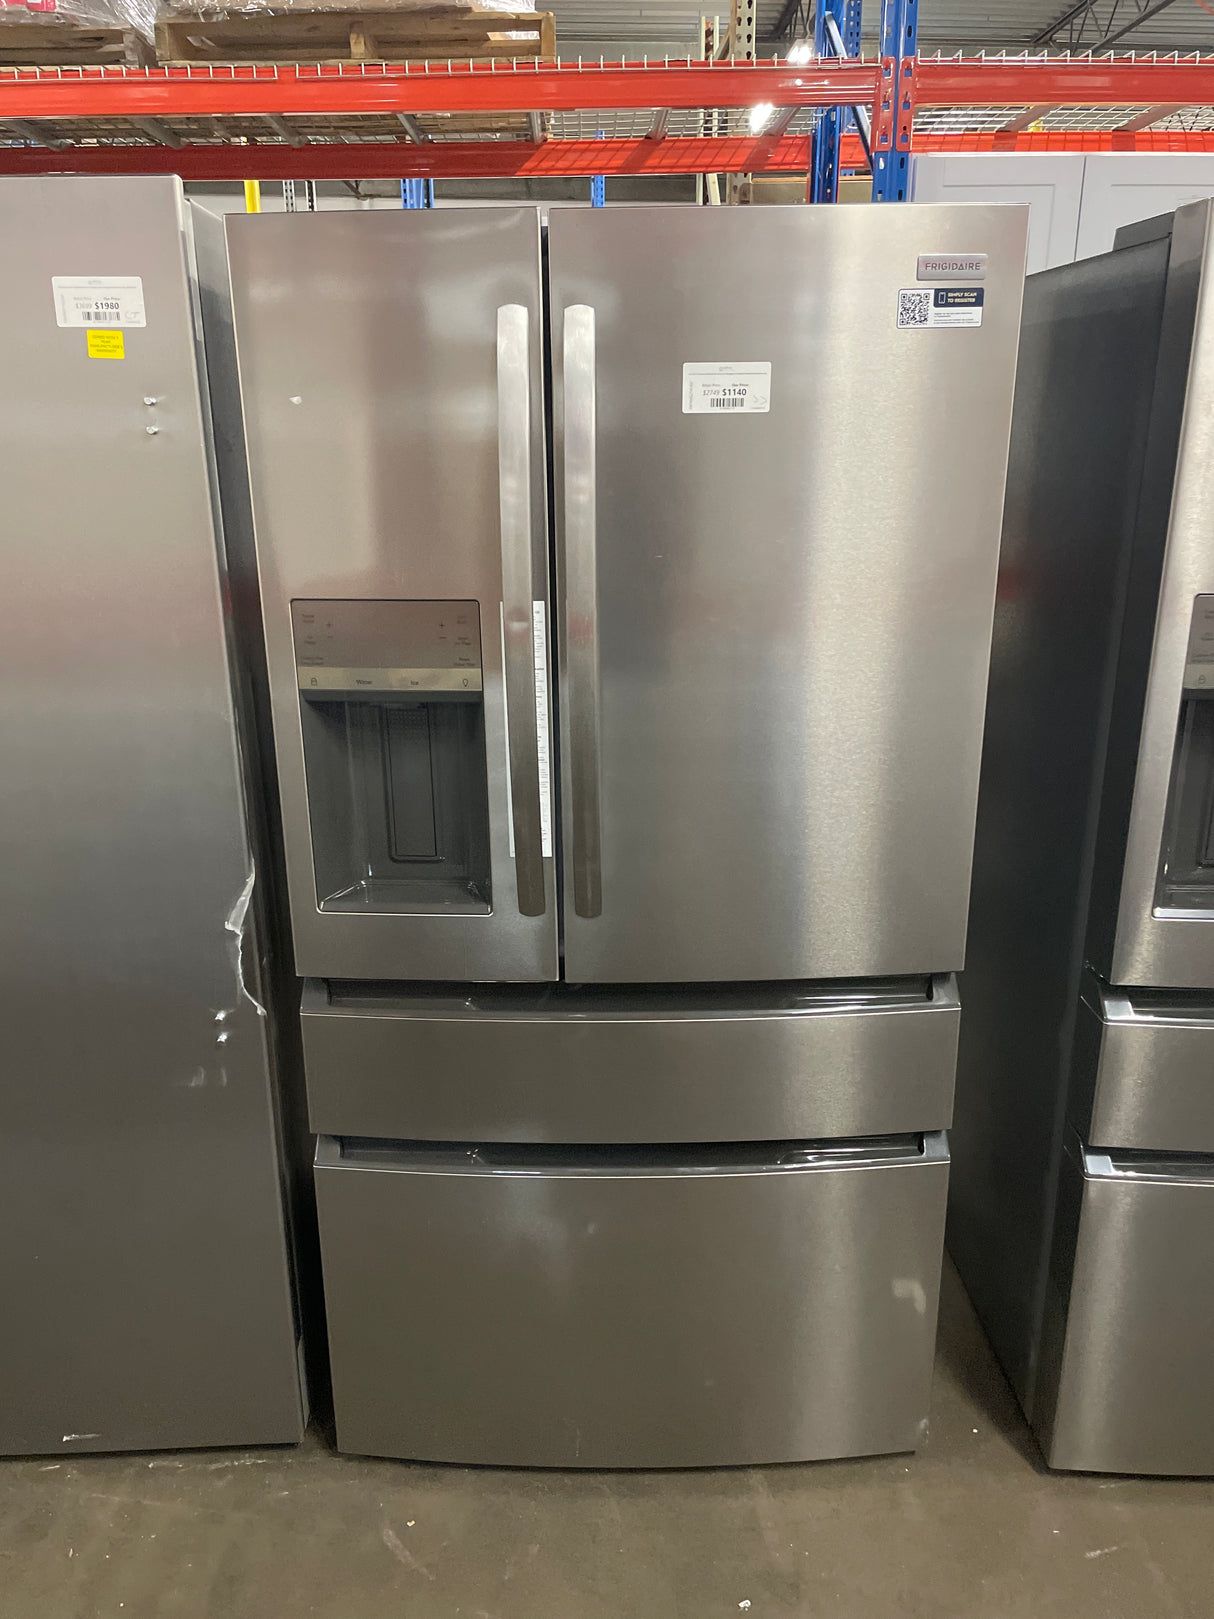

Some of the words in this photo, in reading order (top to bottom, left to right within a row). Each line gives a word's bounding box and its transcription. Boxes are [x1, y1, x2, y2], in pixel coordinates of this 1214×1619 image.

[925, 262, 981, 271] FRIGIDAIRE
[94, 302, 120, 310] $1980
[722, 388, 747, 396] $1140
